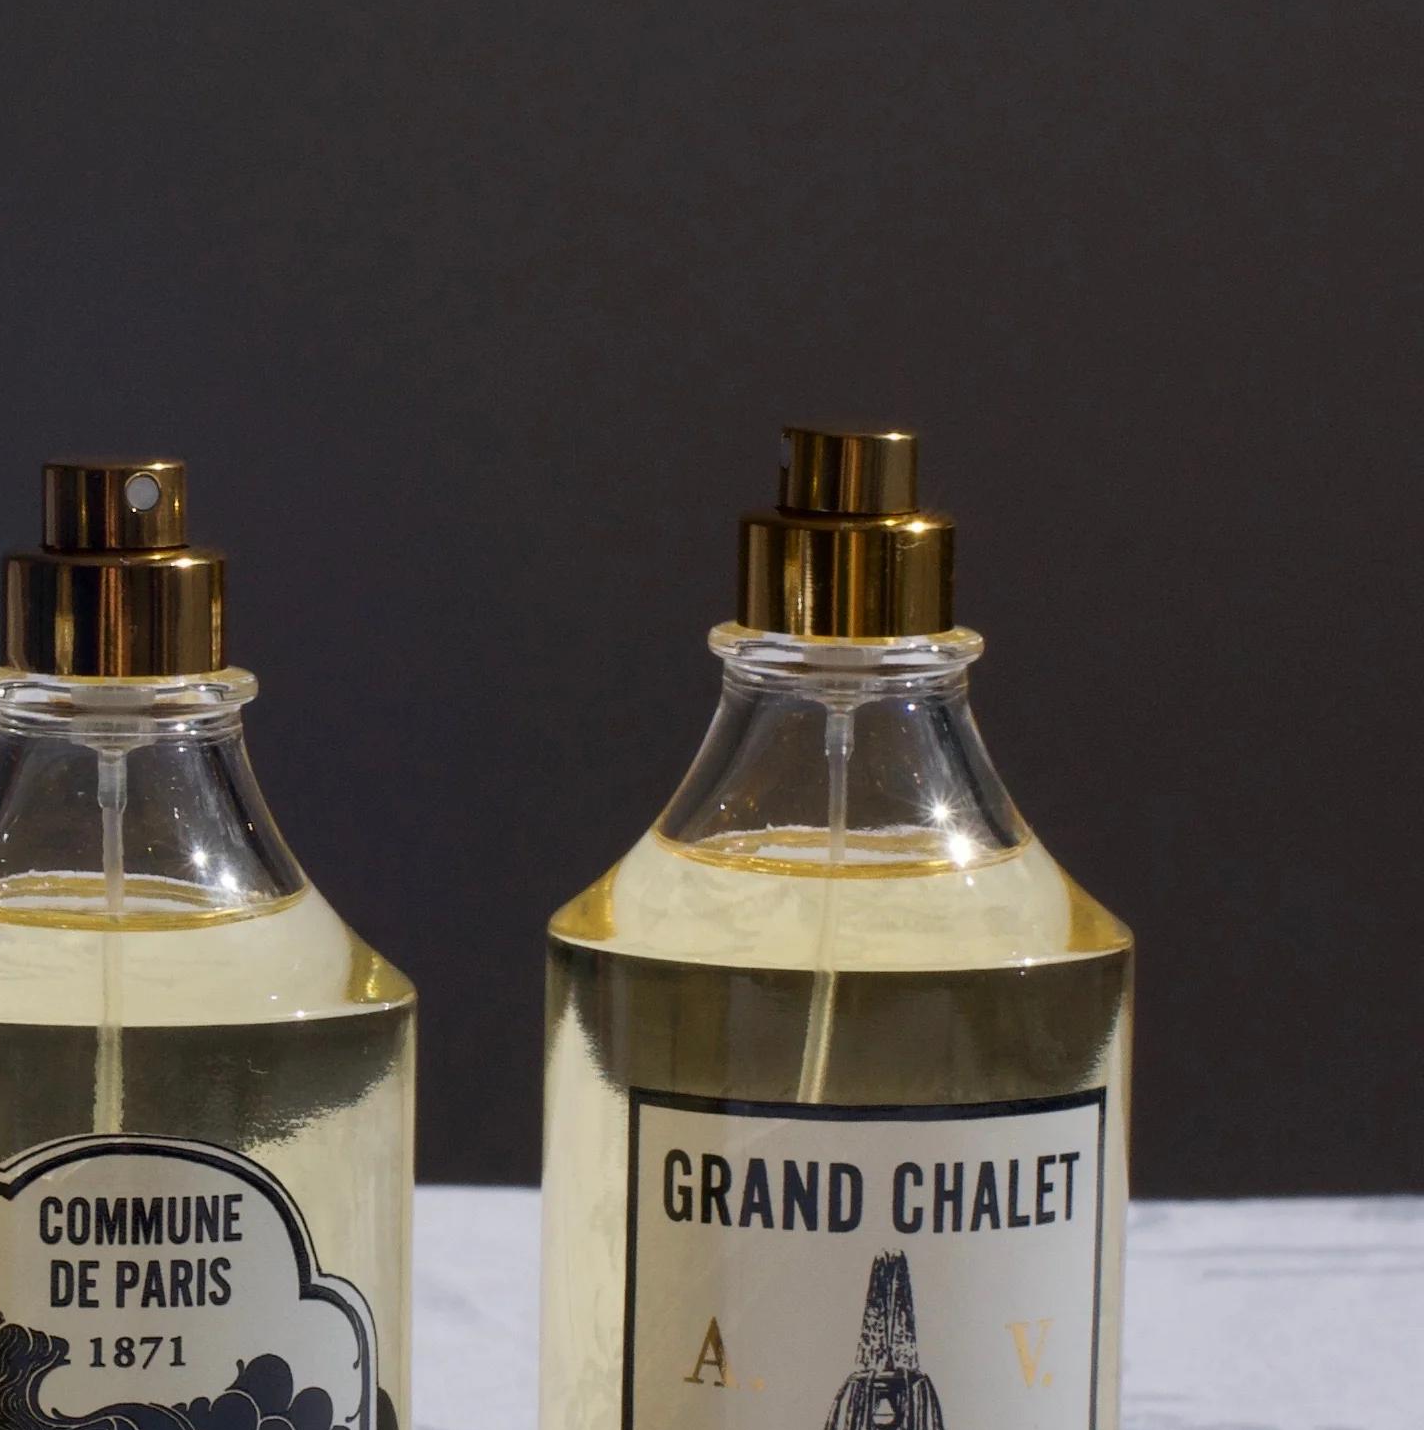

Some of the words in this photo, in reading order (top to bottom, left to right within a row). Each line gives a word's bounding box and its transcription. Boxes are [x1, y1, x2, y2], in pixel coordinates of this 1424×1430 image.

[663, 1148, 863, 1234] GRAND
[891, 1151, 1080, 1235] CHALET
[39, 1193, 243, 1246] COMMUNE
[50, 1259, 100, 1309] DE
[115, 1256, 232, 1309] PARIS
[89, 1335, 187, 1370] 1871
